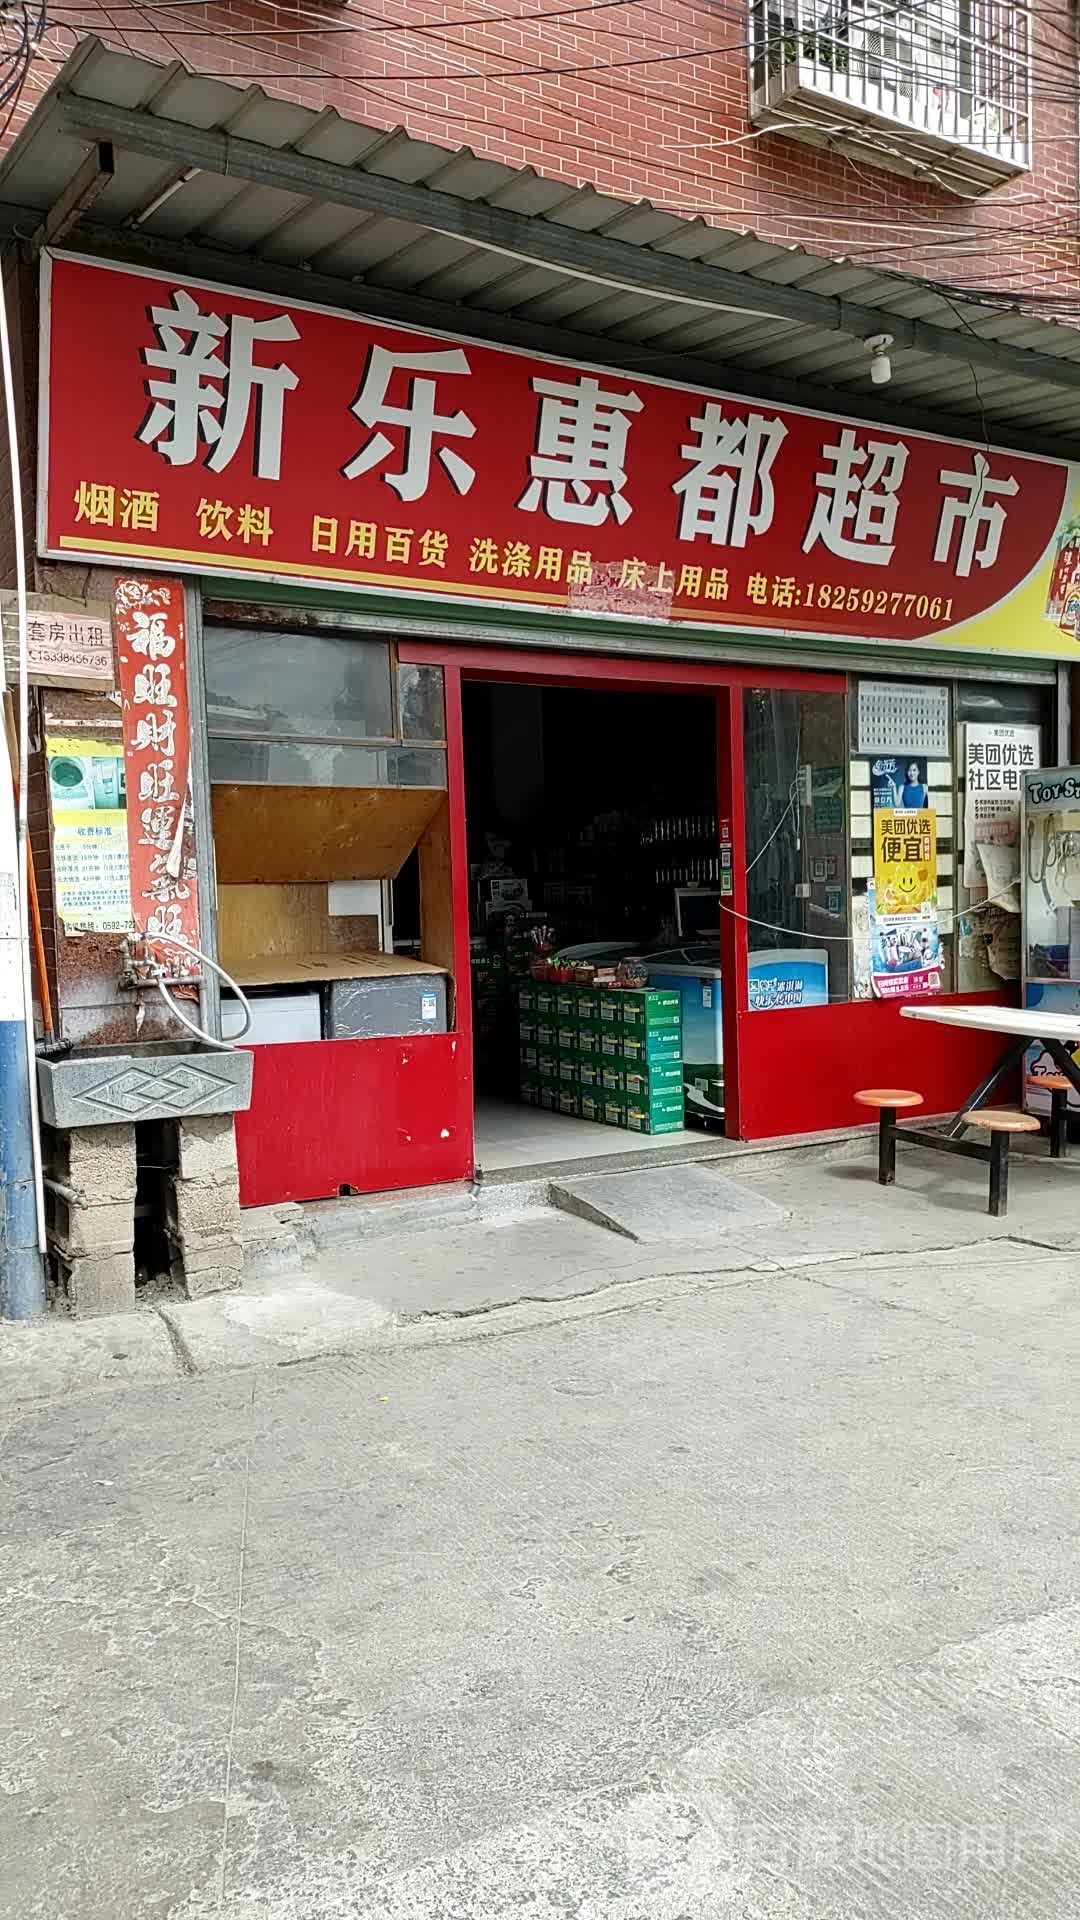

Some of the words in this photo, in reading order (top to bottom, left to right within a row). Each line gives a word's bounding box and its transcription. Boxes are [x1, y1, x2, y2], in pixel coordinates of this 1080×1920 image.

[138, 290, 1020, 577] 新乐惠都超市
[74, 481, 159, 532] 烟酒
[196, 498, 273, 546] 饮料
[311, 515, 449, 569] 日用百货
[469, 537, 593, 586] 洗涤用品
[618, 556, 729, 601] 床上用品
[746, 572, 954, 622] 电话:18259277061
[27, 620, 105, 647] 套房出租
[967, 743, 1034, 766] 美团优选
[967, 768, 1022, 792] 社区电
[881, 818, 931, 836] 美团优选
[881, 837, 922, 863] 便宜
